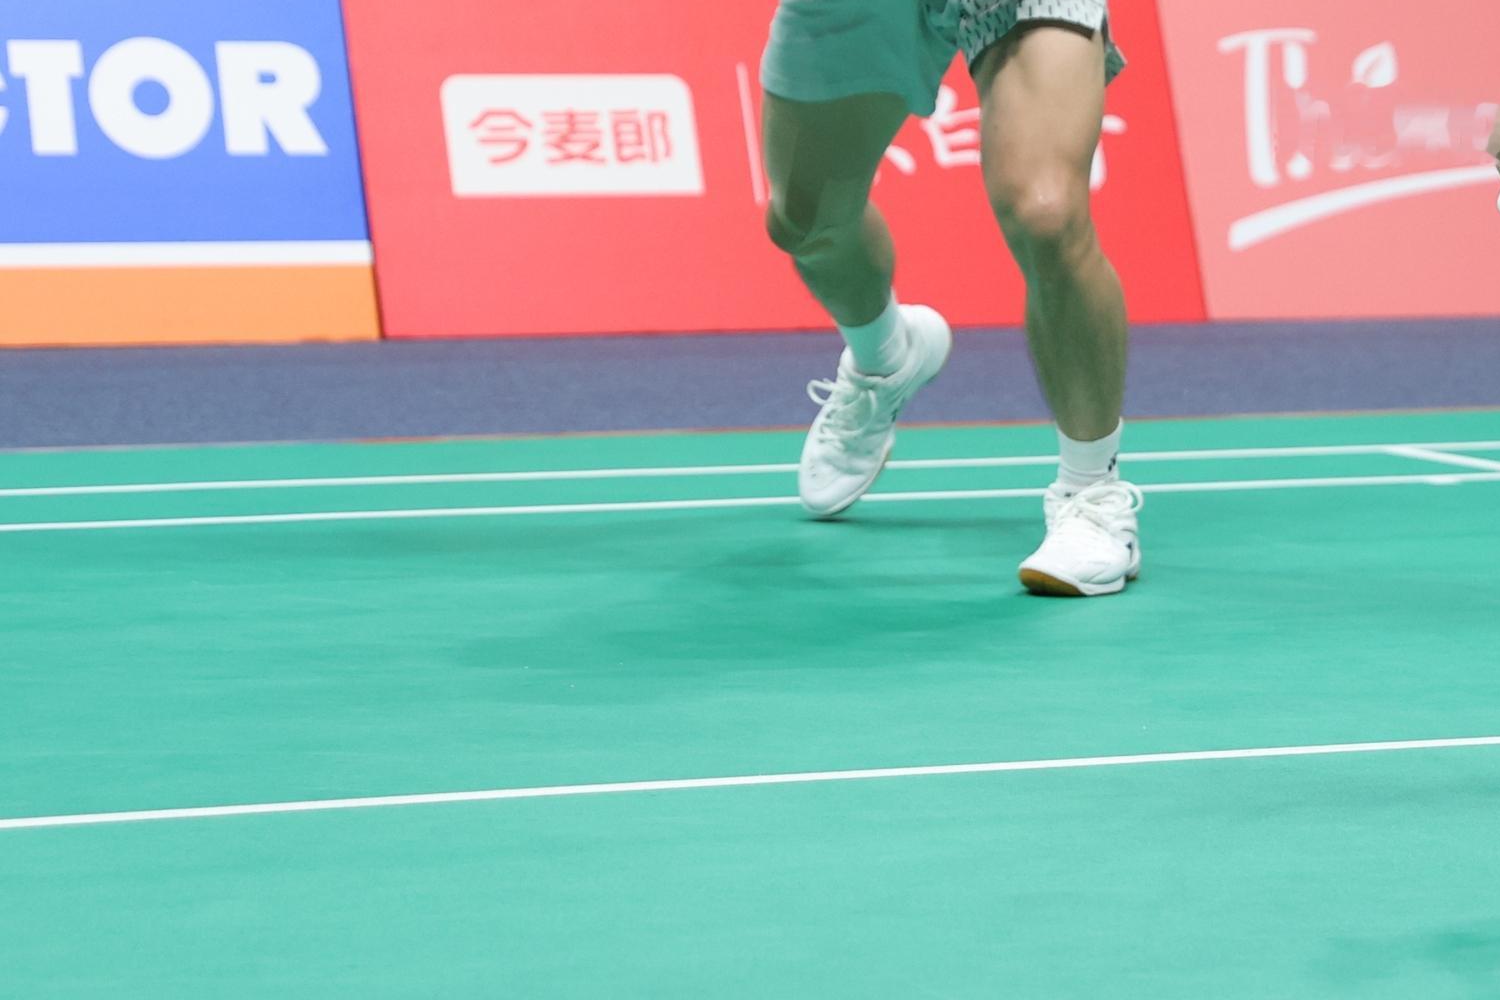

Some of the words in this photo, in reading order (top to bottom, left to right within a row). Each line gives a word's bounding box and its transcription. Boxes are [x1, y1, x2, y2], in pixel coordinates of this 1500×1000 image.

[0, 36, 328, 159] TOR
[468, 108, 673, 166] 今麦郎
